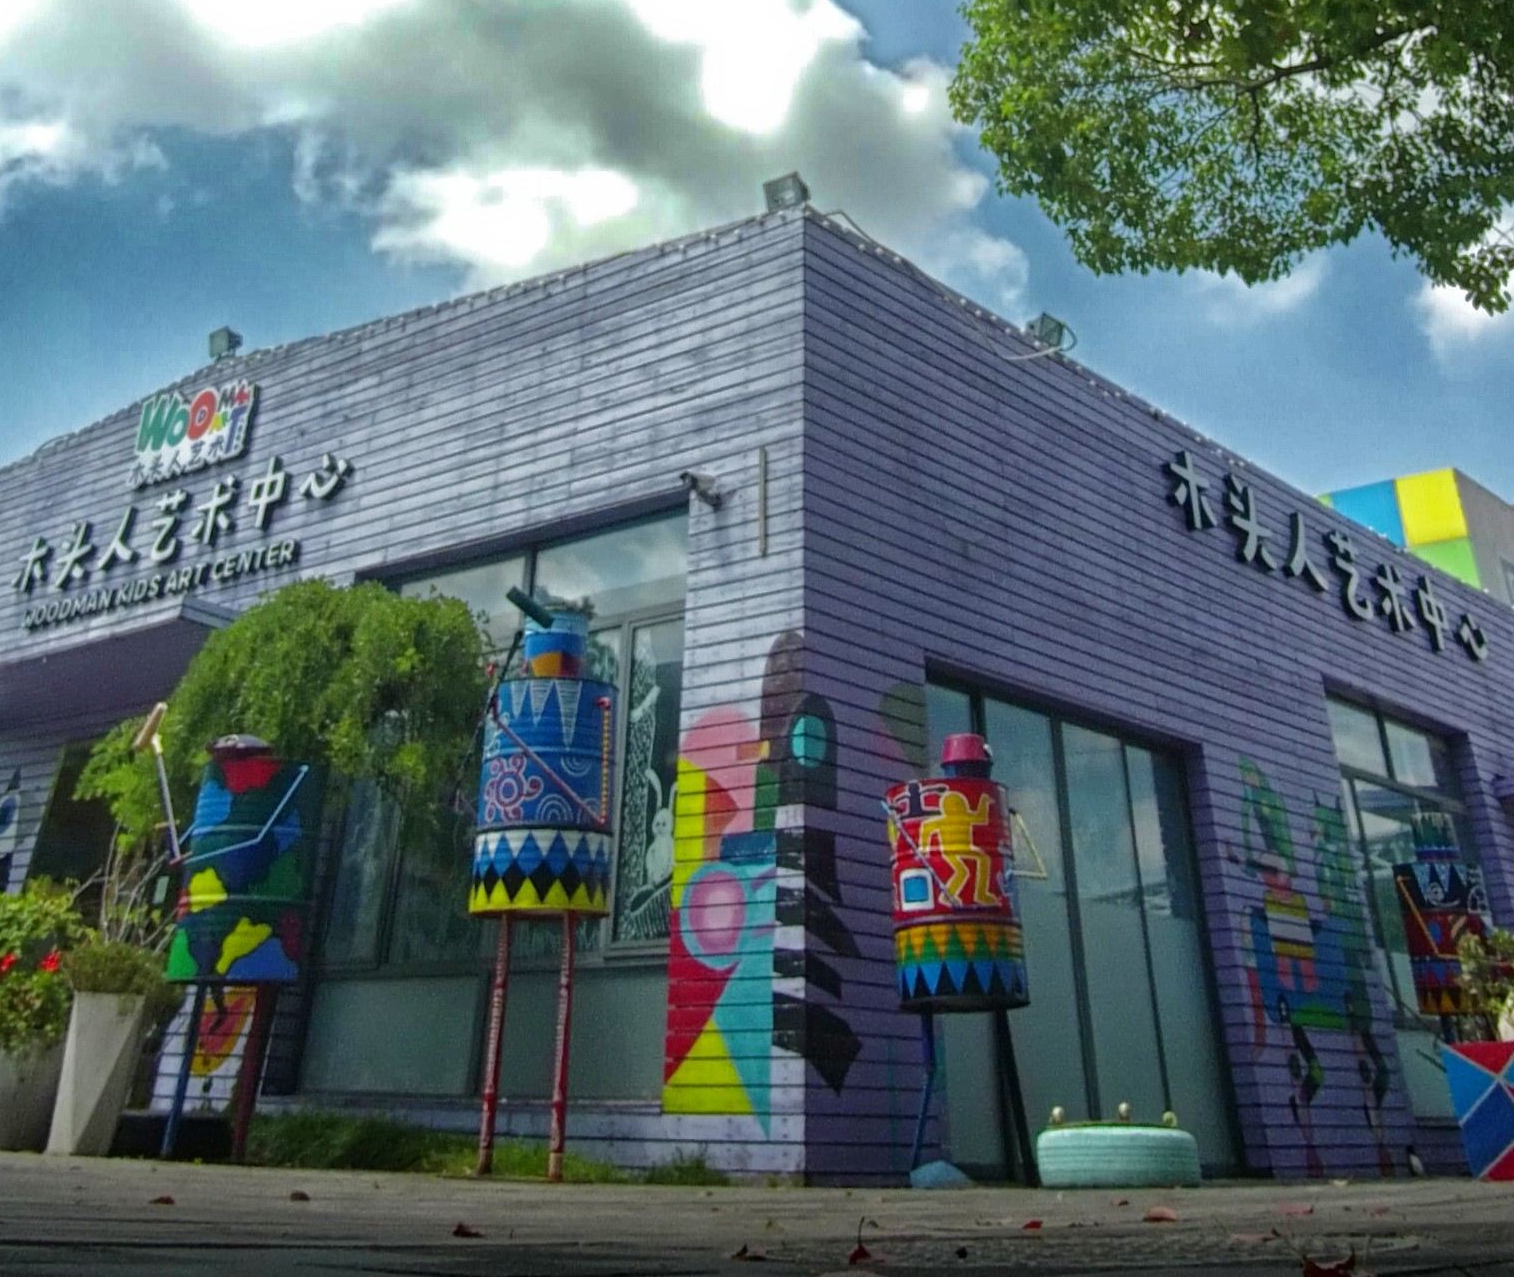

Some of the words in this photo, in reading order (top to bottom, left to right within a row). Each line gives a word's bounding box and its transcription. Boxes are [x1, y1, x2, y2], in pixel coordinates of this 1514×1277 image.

[127, 435, 226, 486] 木头人艺术
[12, 454, 353, 593] 木头人艺术中心
[1163, 449, 1489, 661] 木头人艺术中心
[22, 587, 114, 629] WOODMAN
[116, 574, 161, 607] KIDS
[162, 562, 209, 596] ART
[210, 538, 299, 583] CENTER
